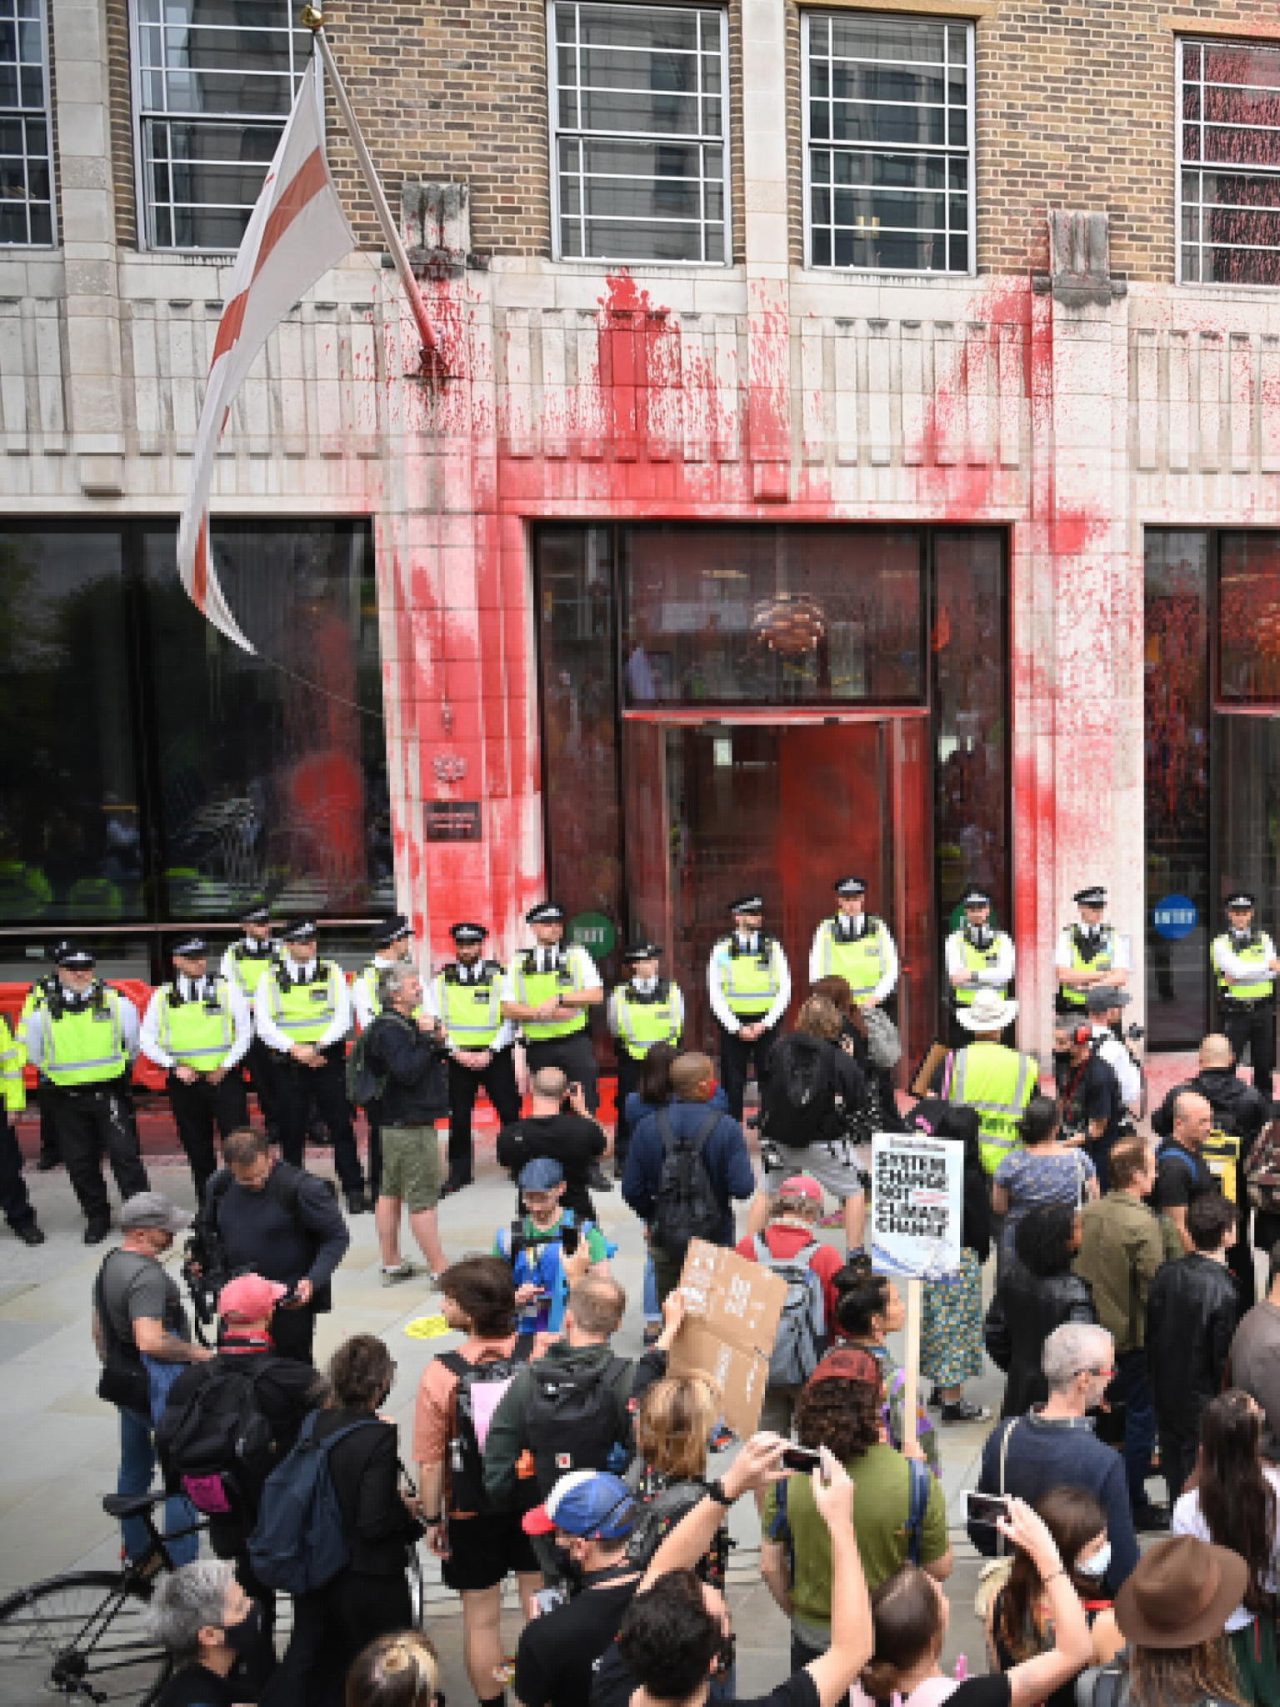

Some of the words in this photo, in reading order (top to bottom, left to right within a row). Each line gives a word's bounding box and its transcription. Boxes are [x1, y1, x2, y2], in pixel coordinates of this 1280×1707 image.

[1154, 908, 1196, 924] ENTRY
[876, 1152, 946, 1173] SYSTEM
[876, 1169, 949, 1190] CHANGE
[876, 1185, 911, 1201] NOT
